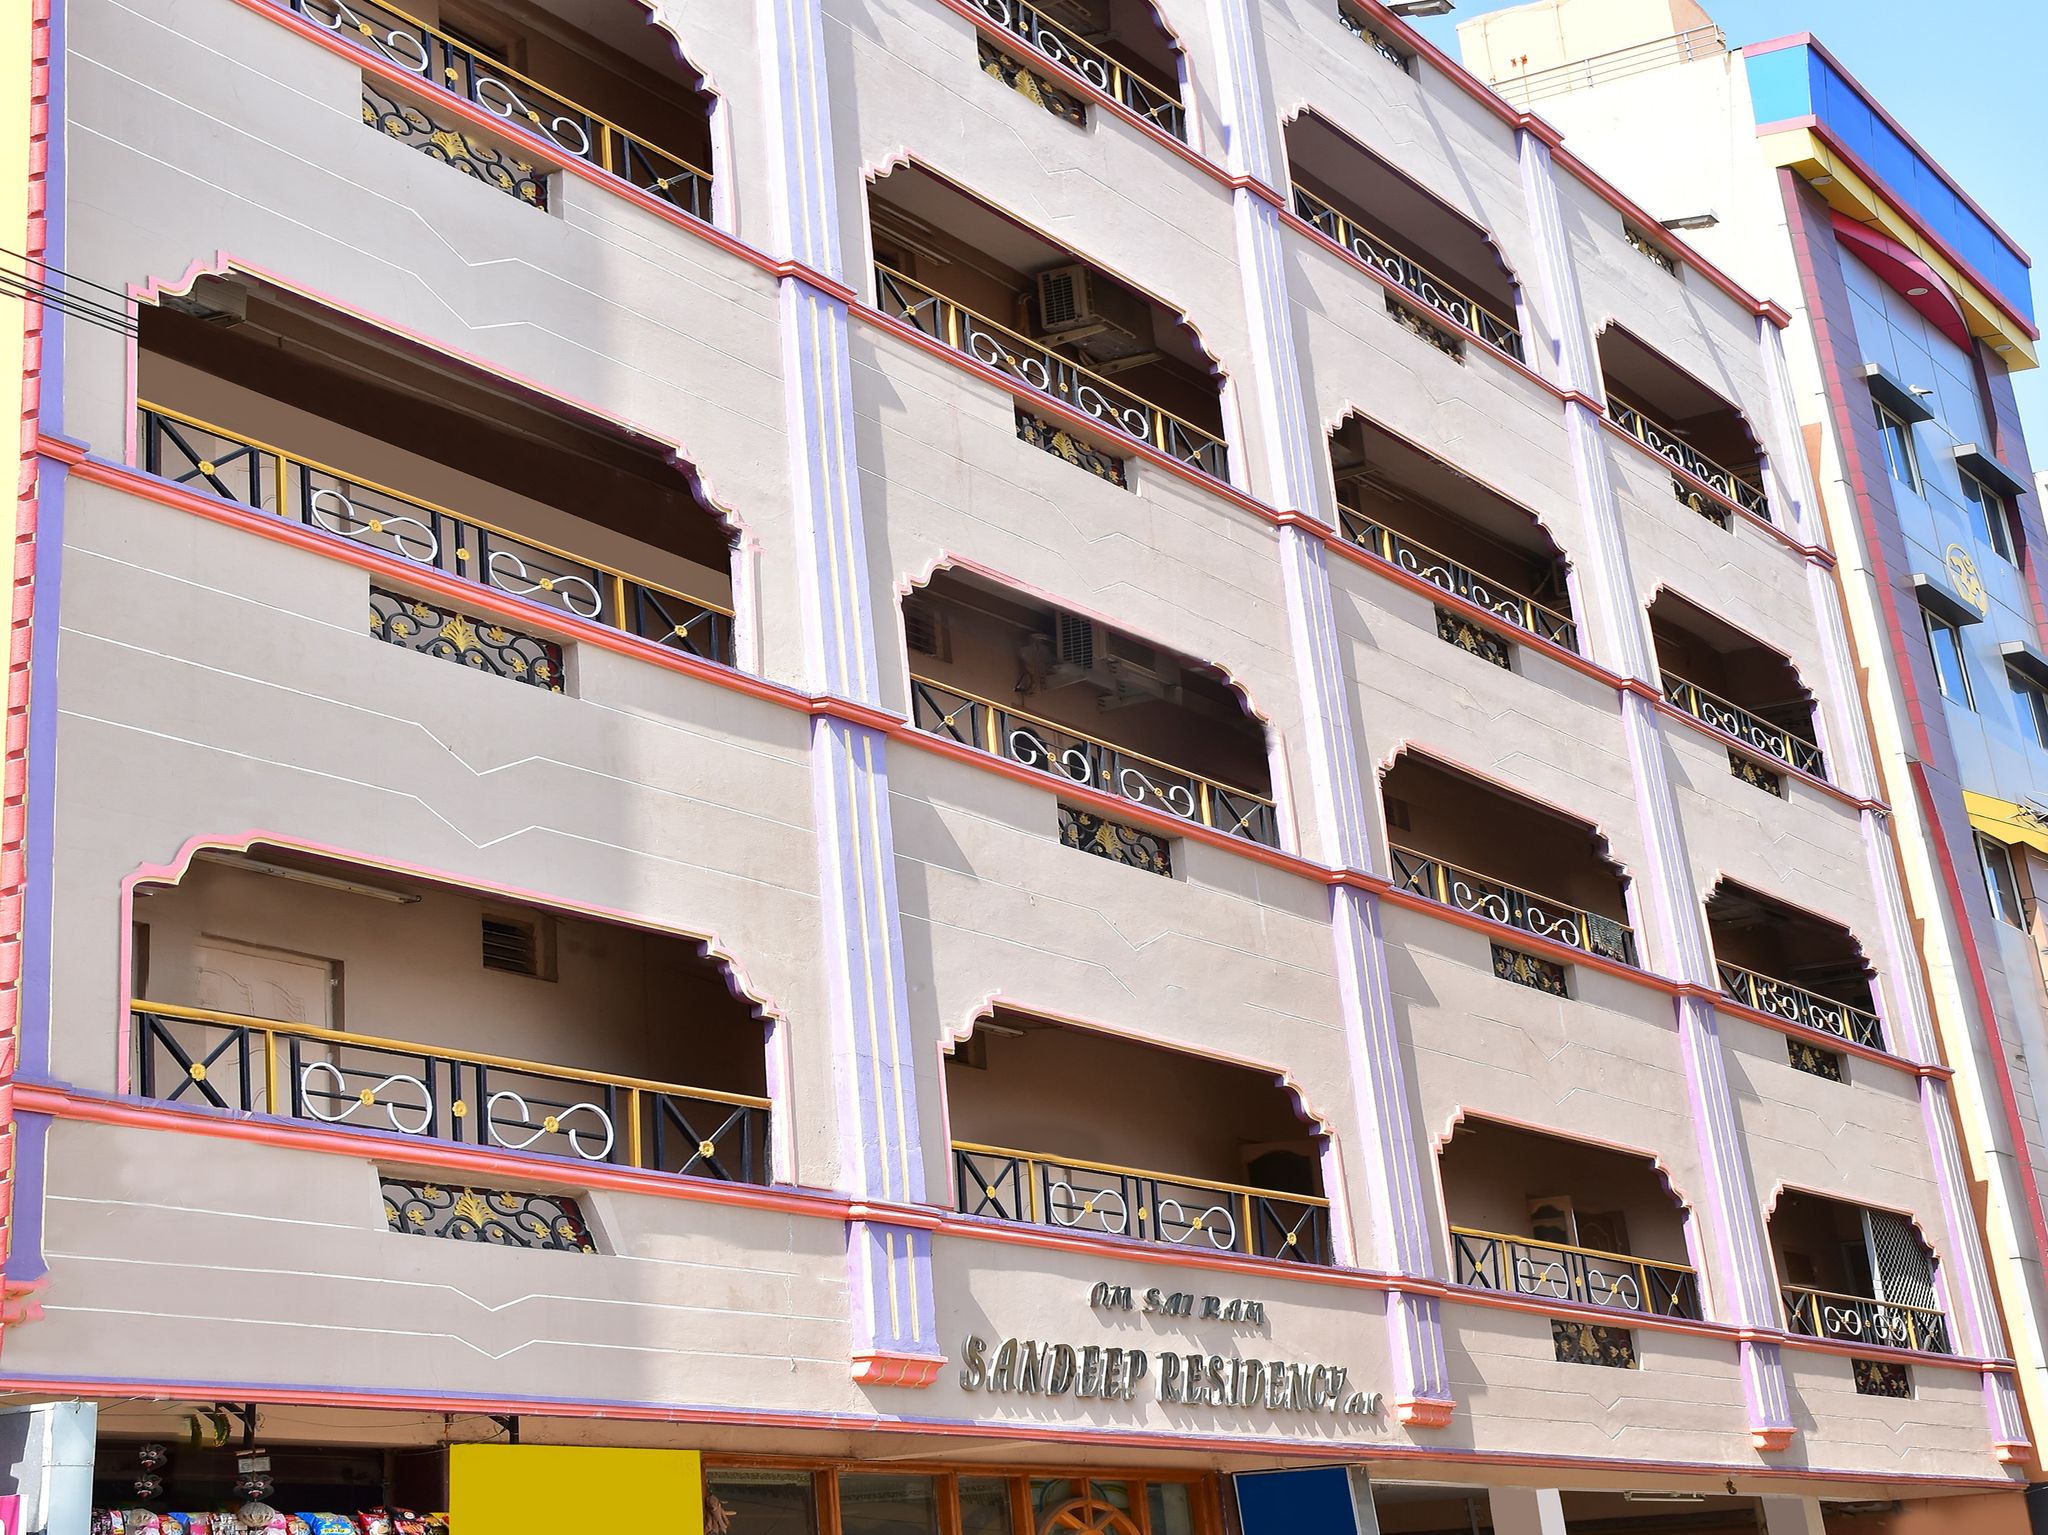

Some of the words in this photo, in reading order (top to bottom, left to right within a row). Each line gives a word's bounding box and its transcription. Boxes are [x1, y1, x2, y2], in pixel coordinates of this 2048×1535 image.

[1088, 1281, 1132, 1311] OM
[1143, 1287, 1194, 1318] SAI
[1200, 1295, 1265, 1326] RAM
[959, 1334, 1148, 1401] SANDEEP
[1155, 1351, 1348, 1414] RESIDENCY
